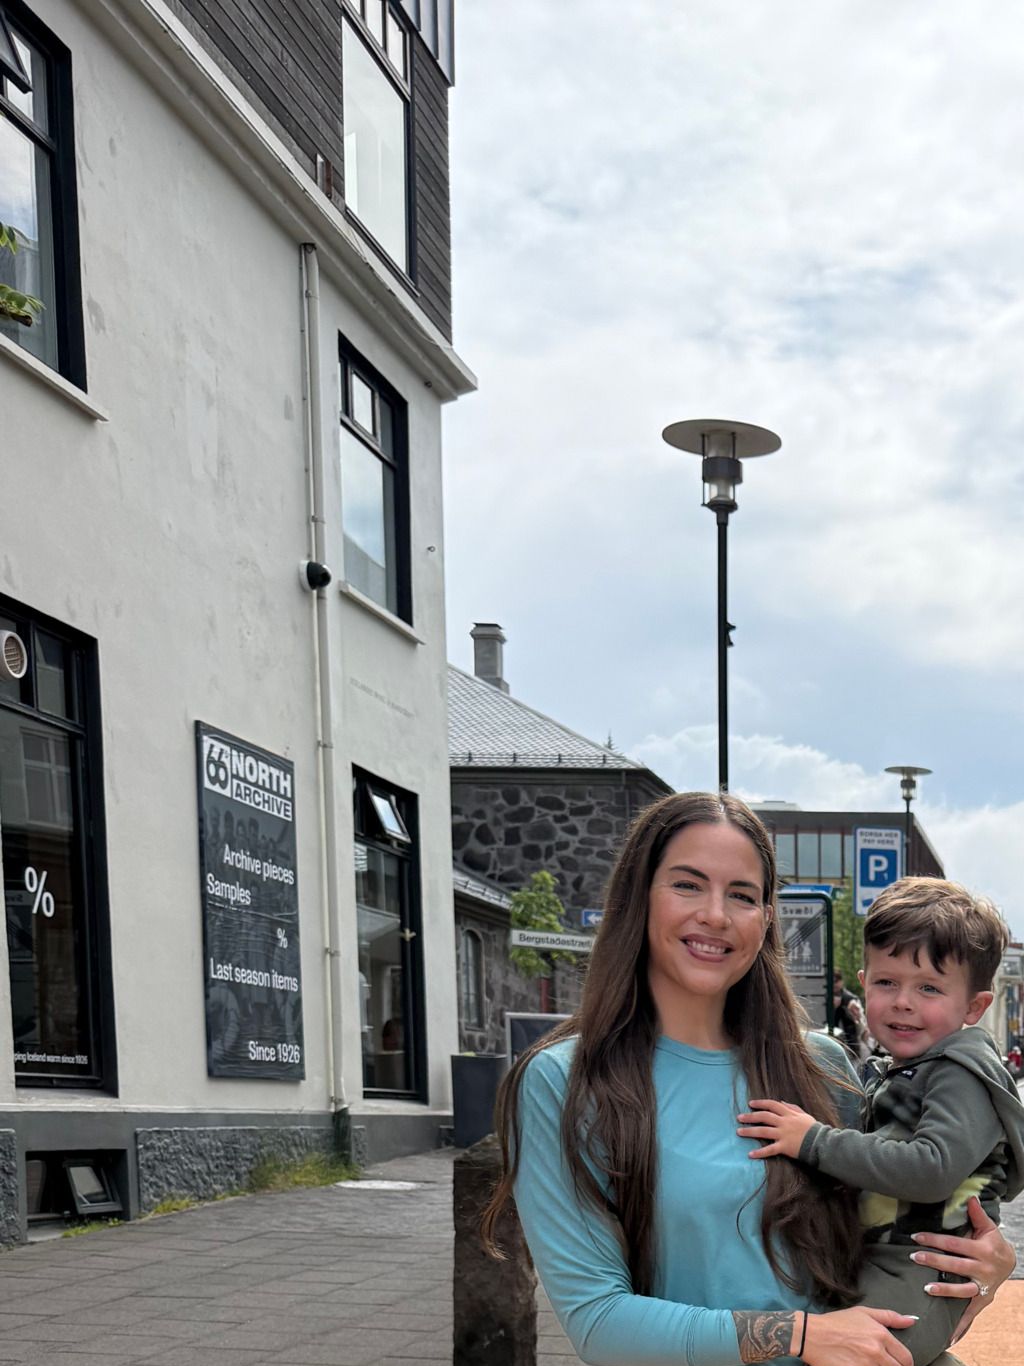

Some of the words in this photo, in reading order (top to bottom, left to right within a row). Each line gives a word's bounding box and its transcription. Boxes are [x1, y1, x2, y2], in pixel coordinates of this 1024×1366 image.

[232, 749, 291, 799] NORTH
[235, 783, 291, 818] ARCHIVE
[224, 844, 261, 876] Archive
[263, 857, 294, 885] pieces
[868, 854, 888, 881] P
[24, 865, 54, 918] %
[207, 873, 251, 904] Samples
[782, 905, 813, 914] Svæði
[277, 928, 287, 949] %
[211, 958, 233, 981] Last
[235, 964, 270, 989] season
[272, 967, 298, 992] items
[249, 1041, 276, 1062] Since
[277, 1042, 300, 1064] 1926
